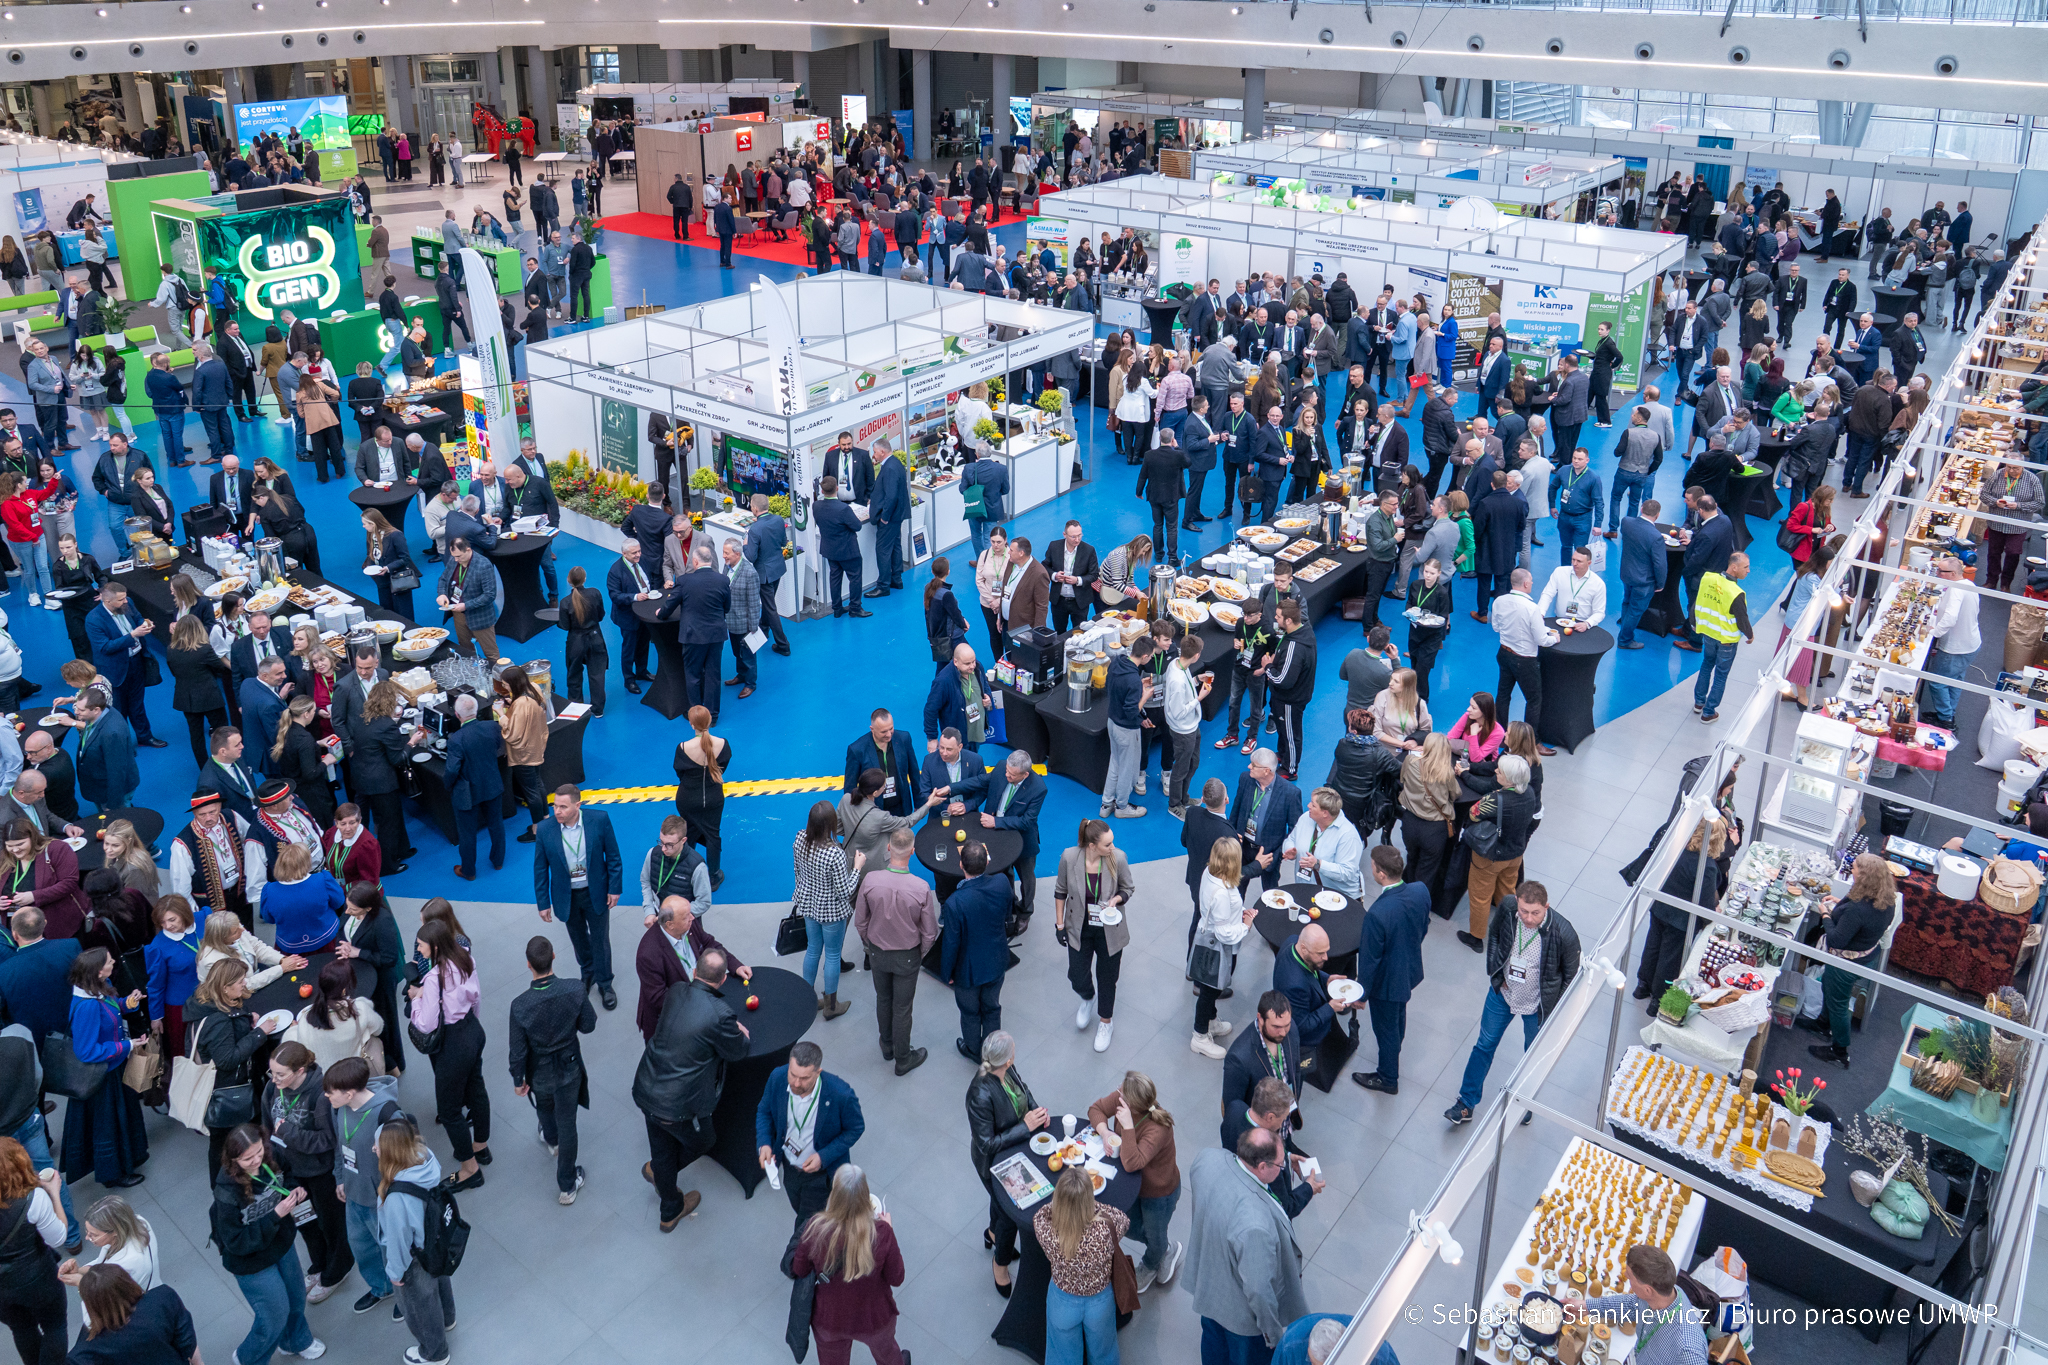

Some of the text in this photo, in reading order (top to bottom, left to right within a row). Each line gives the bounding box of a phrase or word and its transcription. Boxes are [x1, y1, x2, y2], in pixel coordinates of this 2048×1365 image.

[251, 105, 286, 113] CORTEVA
[253, 116, 288, 126] przyszłością
[266, 240, 309, 268] BIO
[1452, 278, 1480, 289] WIESZ,
[269, 276, 320, 305] GEN
[1451, 286, 1490, 298] CO KRYJE
[1450, 298, 1480, 307] TWOJA
[1604, 294, 1630, 303] MAG
[1517, 300, 1574, 312] apm kampa
[971, 352, 1005, 368] STADO OGIERÓW
[910, 373, 946, 389] STADNINA KONI
[747, 419, 759, 428] GRH
[794, 426, 806, 434] OHZ
